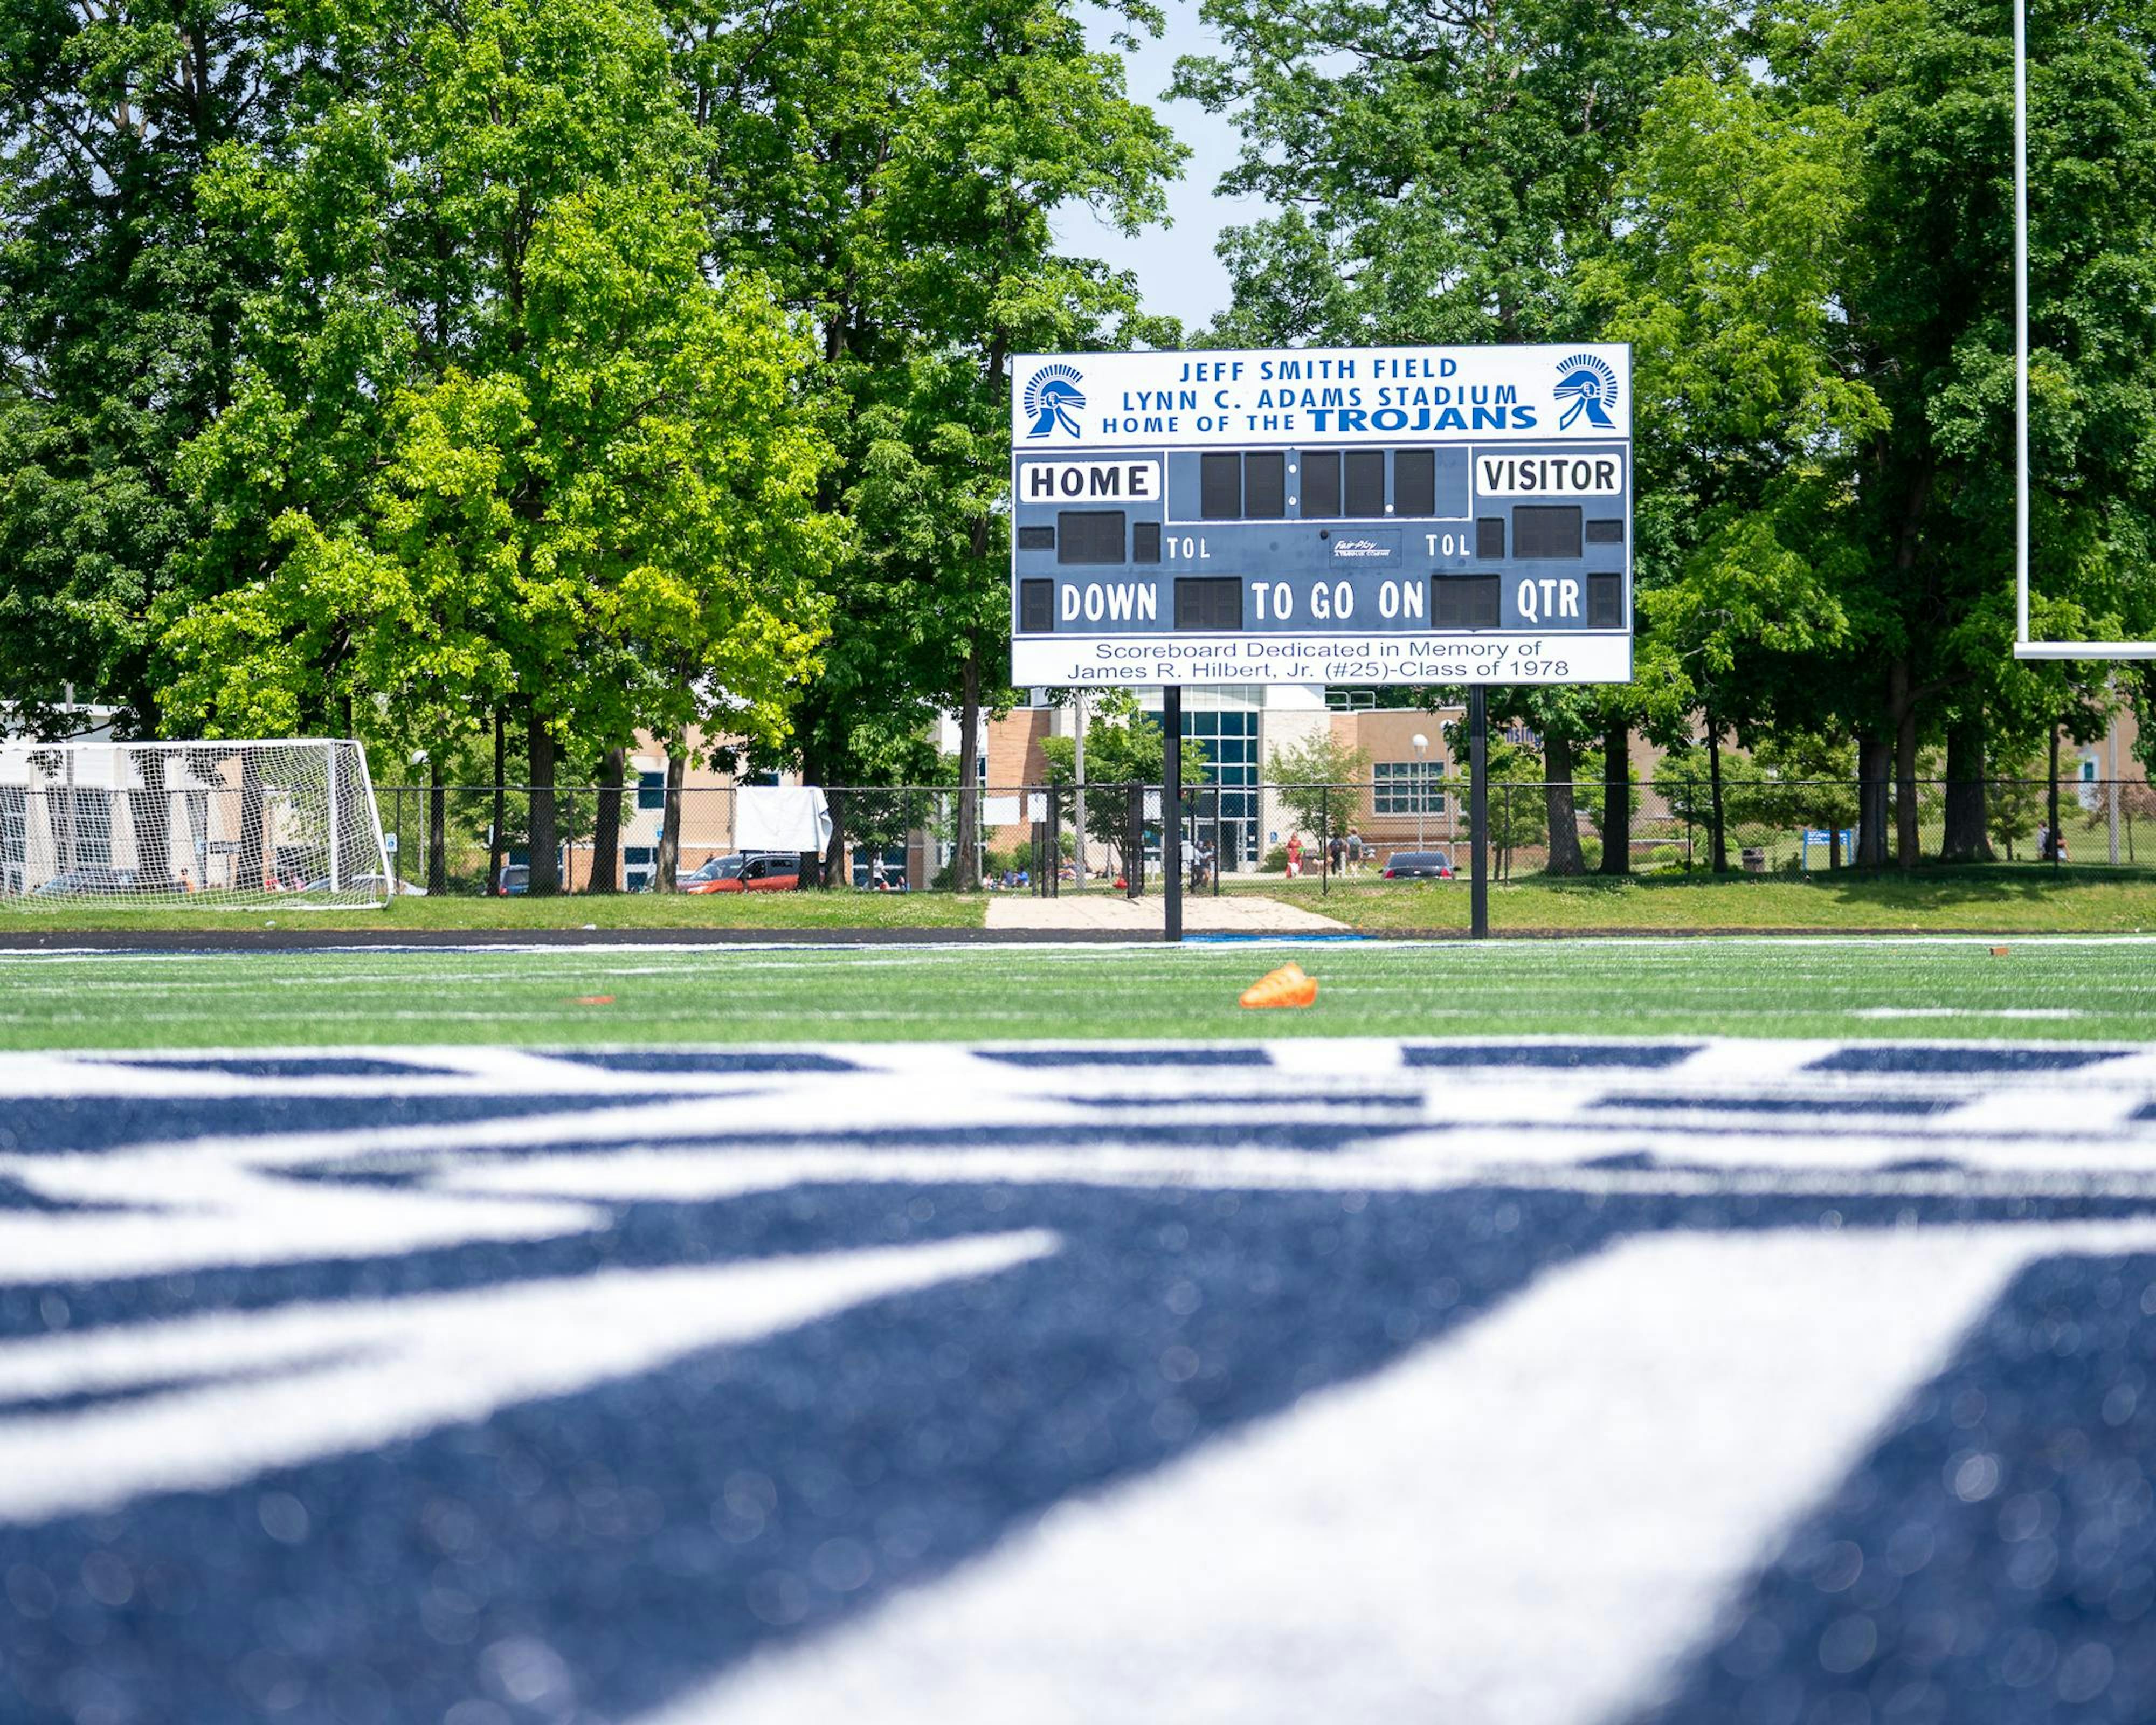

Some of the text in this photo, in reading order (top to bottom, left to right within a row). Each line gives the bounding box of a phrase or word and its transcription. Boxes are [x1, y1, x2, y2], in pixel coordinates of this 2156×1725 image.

[1179, 358, 1457, 382] JEFF SMITH FIELD
[1123, 385, 1517, 411] LYNN C. ADAMS STADIUM
[1102, 406, 1538, 433] HOME OF THE TROJANS
[1031, 466, 1149, 497] HOME
[1484, 459, 1615, 491] VISITOR
[1166, 536, 1210, 559] TOL
[1425, 534, 1471, 556] TOL
[1061, 583, 1157, 622] DOWN
[1251, 580, 1423, 620] TO GO ON
[1517, 578, 1579, 623] QTR
[1096, 641, 1542, 659] Scoreboard Dedicated in Memory of
[1068, 660, 1569, 680] James R. Hilbert, Jr. (#25)-Class of 1978
